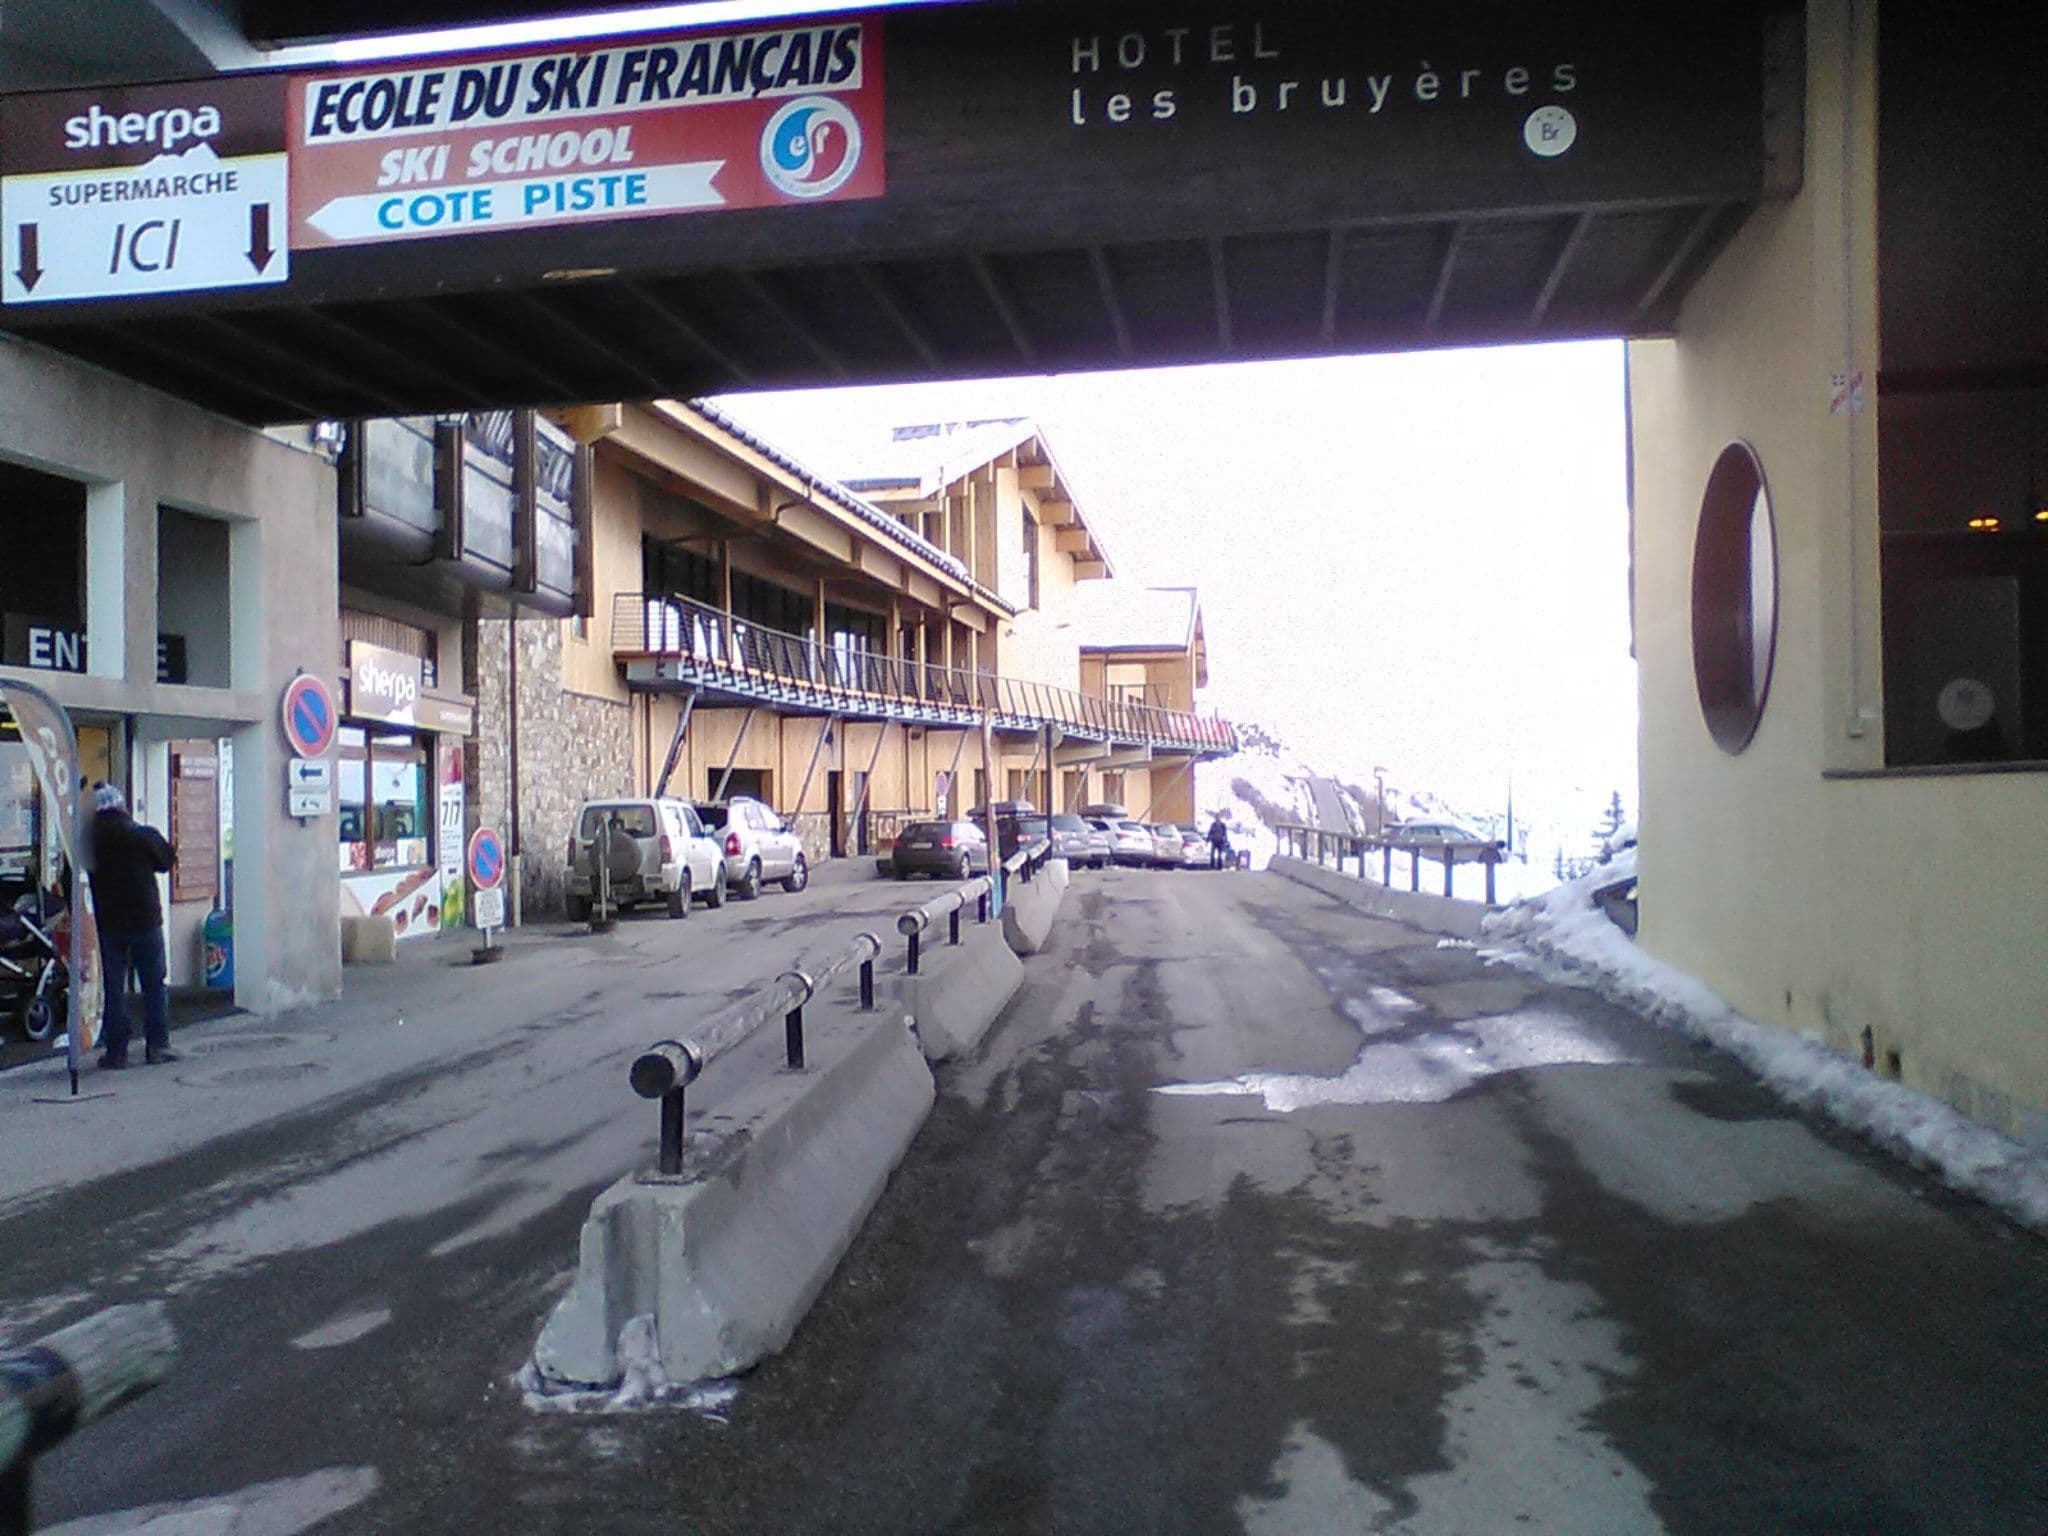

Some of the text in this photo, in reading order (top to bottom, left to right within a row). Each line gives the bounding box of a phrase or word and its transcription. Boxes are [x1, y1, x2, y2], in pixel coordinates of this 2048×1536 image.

[1071, 22, 1280, 73] HOTEL
[309, 26, 861, 137] ECOLE DU SKI FRANÇAIS
[1072, 60, 1577, 125] les bruyères
[64, 105, 221, 149] sherpa
[377, 126, 635, 186] SKI SCHOOL
[49, 170, 239, 206] SUPERMARCHE
[377, 172, 648, 229] COTE PISTE
[108, 218, 182, 275] ICI
[359, 659, 416, 706] sherpa
[441, 801, 461, 828] 7/7
